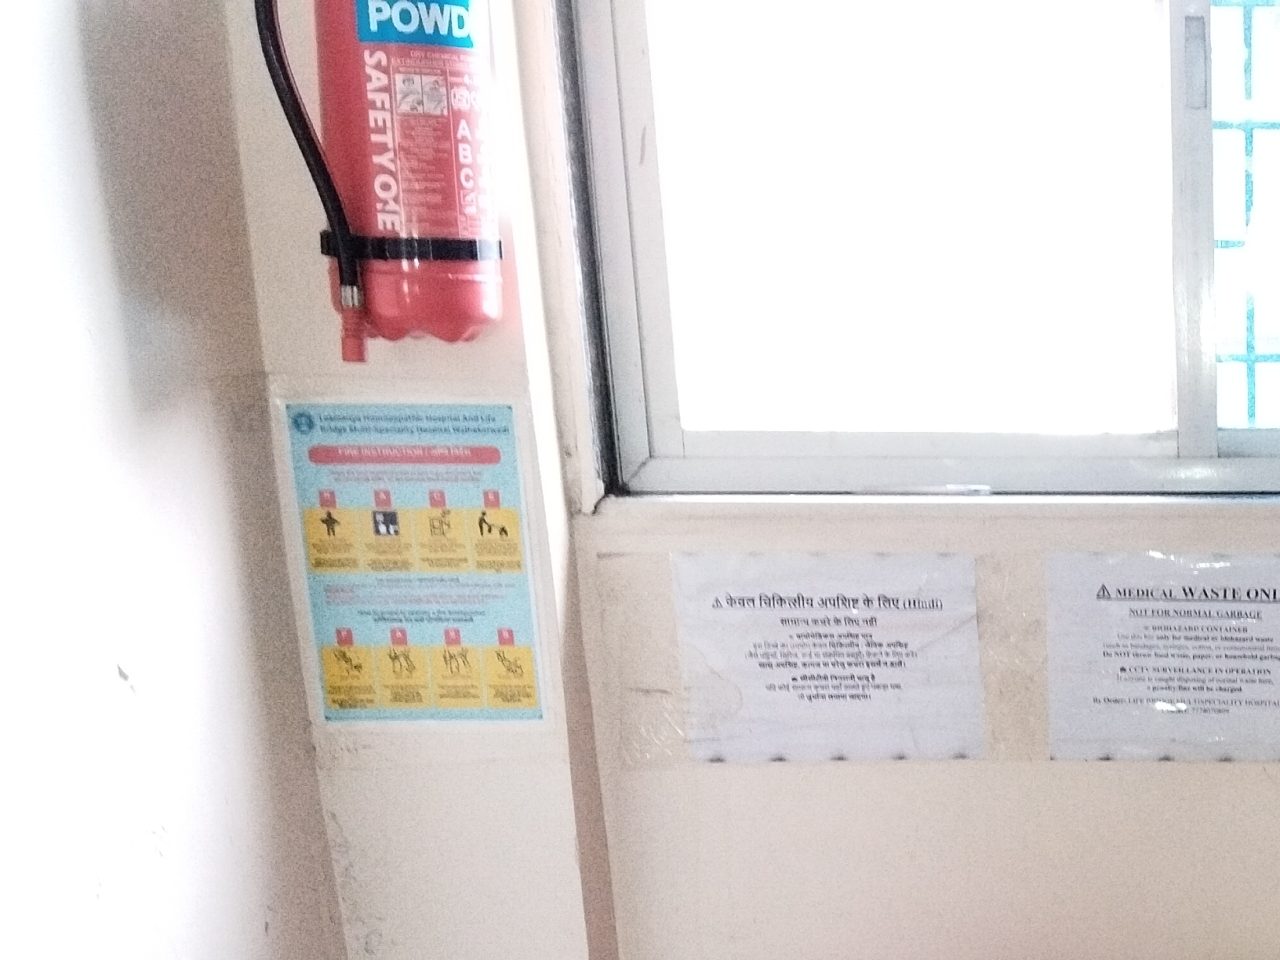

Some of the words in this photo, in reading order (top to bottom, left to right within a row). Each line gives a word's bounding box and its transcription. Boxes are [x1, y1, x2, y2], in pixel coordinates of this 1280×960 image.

[368, 0, 470, 38] POWD
[1116, 588, 1177, 599] MEDICAL
[1181, 586, 1242, 600] WASTE
[1129, 608, 1148, 617] NOT
[1151, 608, 1171, 617] FOR
[1173, 609, 1214, 618] NORMAL
